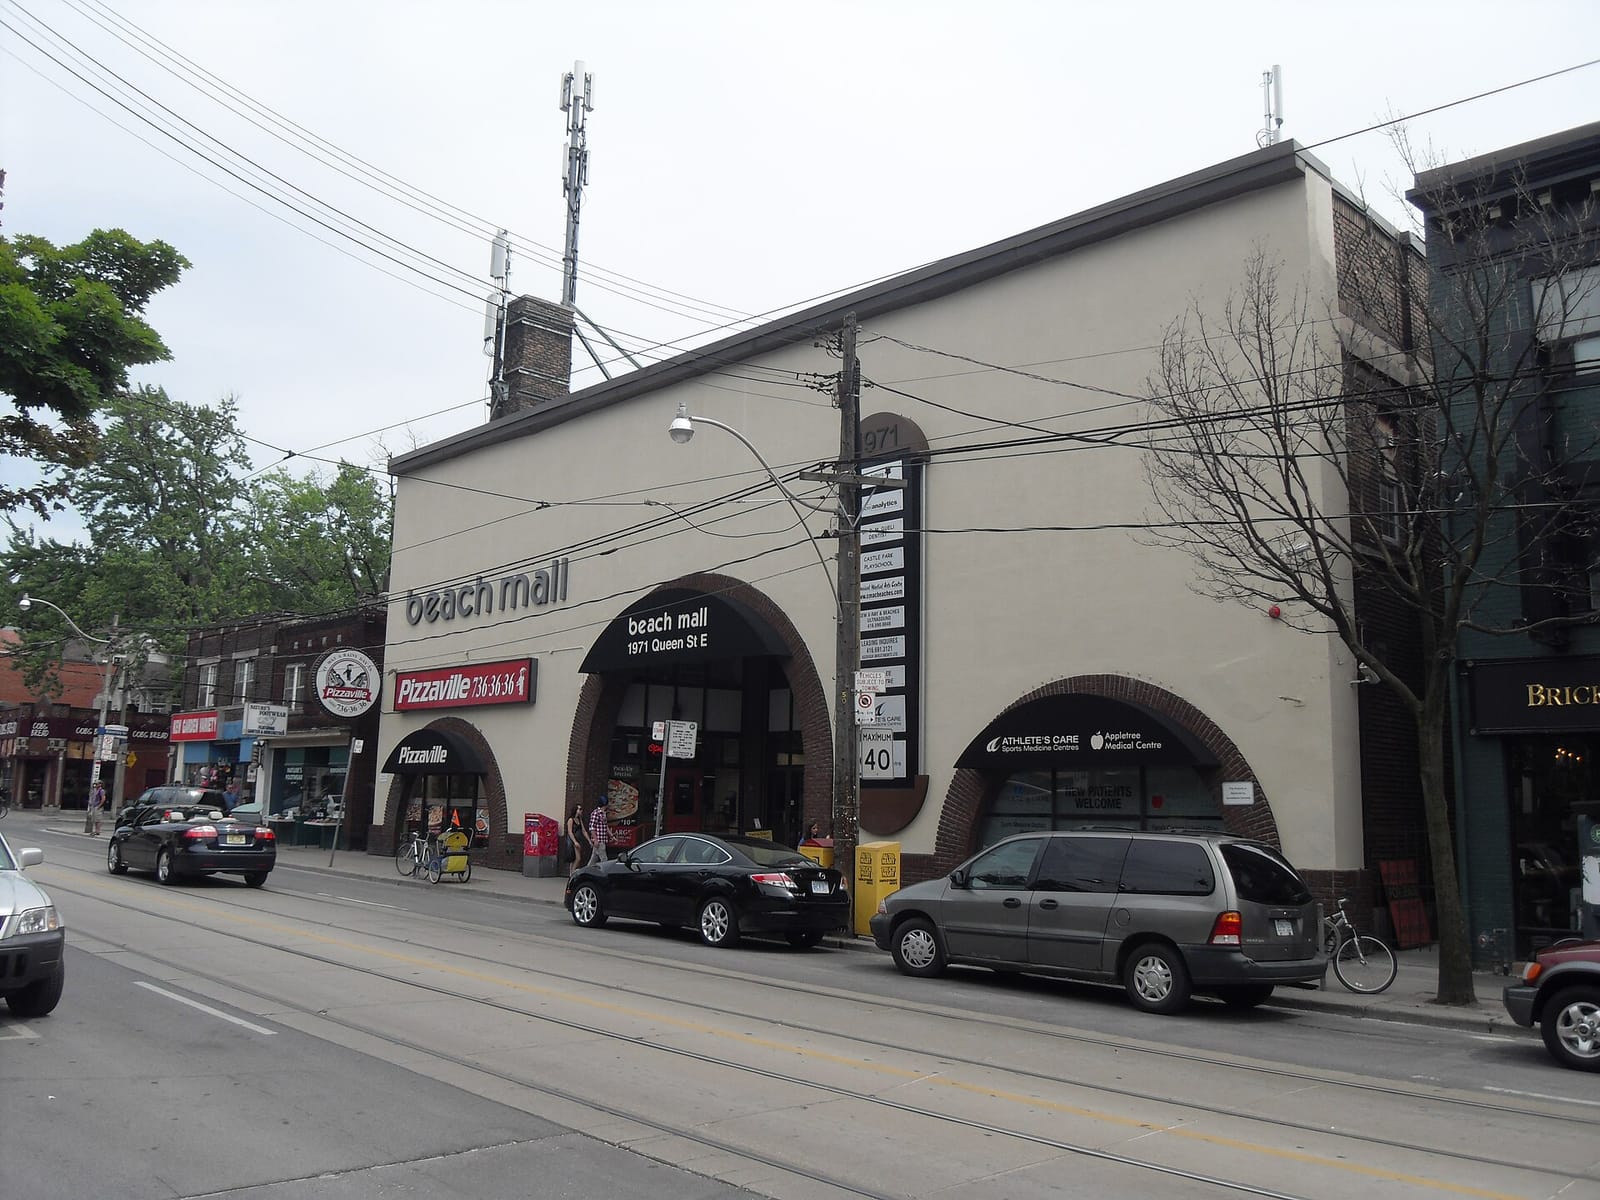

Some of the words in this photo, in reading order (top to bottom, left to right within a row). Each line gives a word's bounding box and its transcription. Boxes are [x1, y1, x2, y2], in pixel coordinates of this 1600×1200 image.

[863, 424, 899, 454] 971
[864, 560, 894, 570] PLAYSCHOOL
[406, 575, 494, 626] beach
[499, 557, 569, 612] mall
[628, 612, 672, 636] beach
[678, 606, 708, 630] mall
[628, 640, 648, 655] 1971
[652, 638, 684, 652] Queen
[686, 634, 698, 648] St
[700, 633, 708, 647] E
[326, 688, 368, 698] Pizzaville
[398, 674, 471, 704] Pizzaville
[862, 732, 892, 742] MAXIMUM
[1002, 736, 1051, 745] ATHLETE'S
[1052, 735, 1080, 744] CARE
[1104, 731, 1141, 741] Appletree
[1104, 741, 1134, 750] Medical
[1135, 740, 1162, 749] Centre
[398, 745, 448, 764] Pizzaville
[864, 748, 890, 770] 40
[1087, 786, 1132, 798] PATIENTS
[1075, 798, 1122, 808] WELCOME
